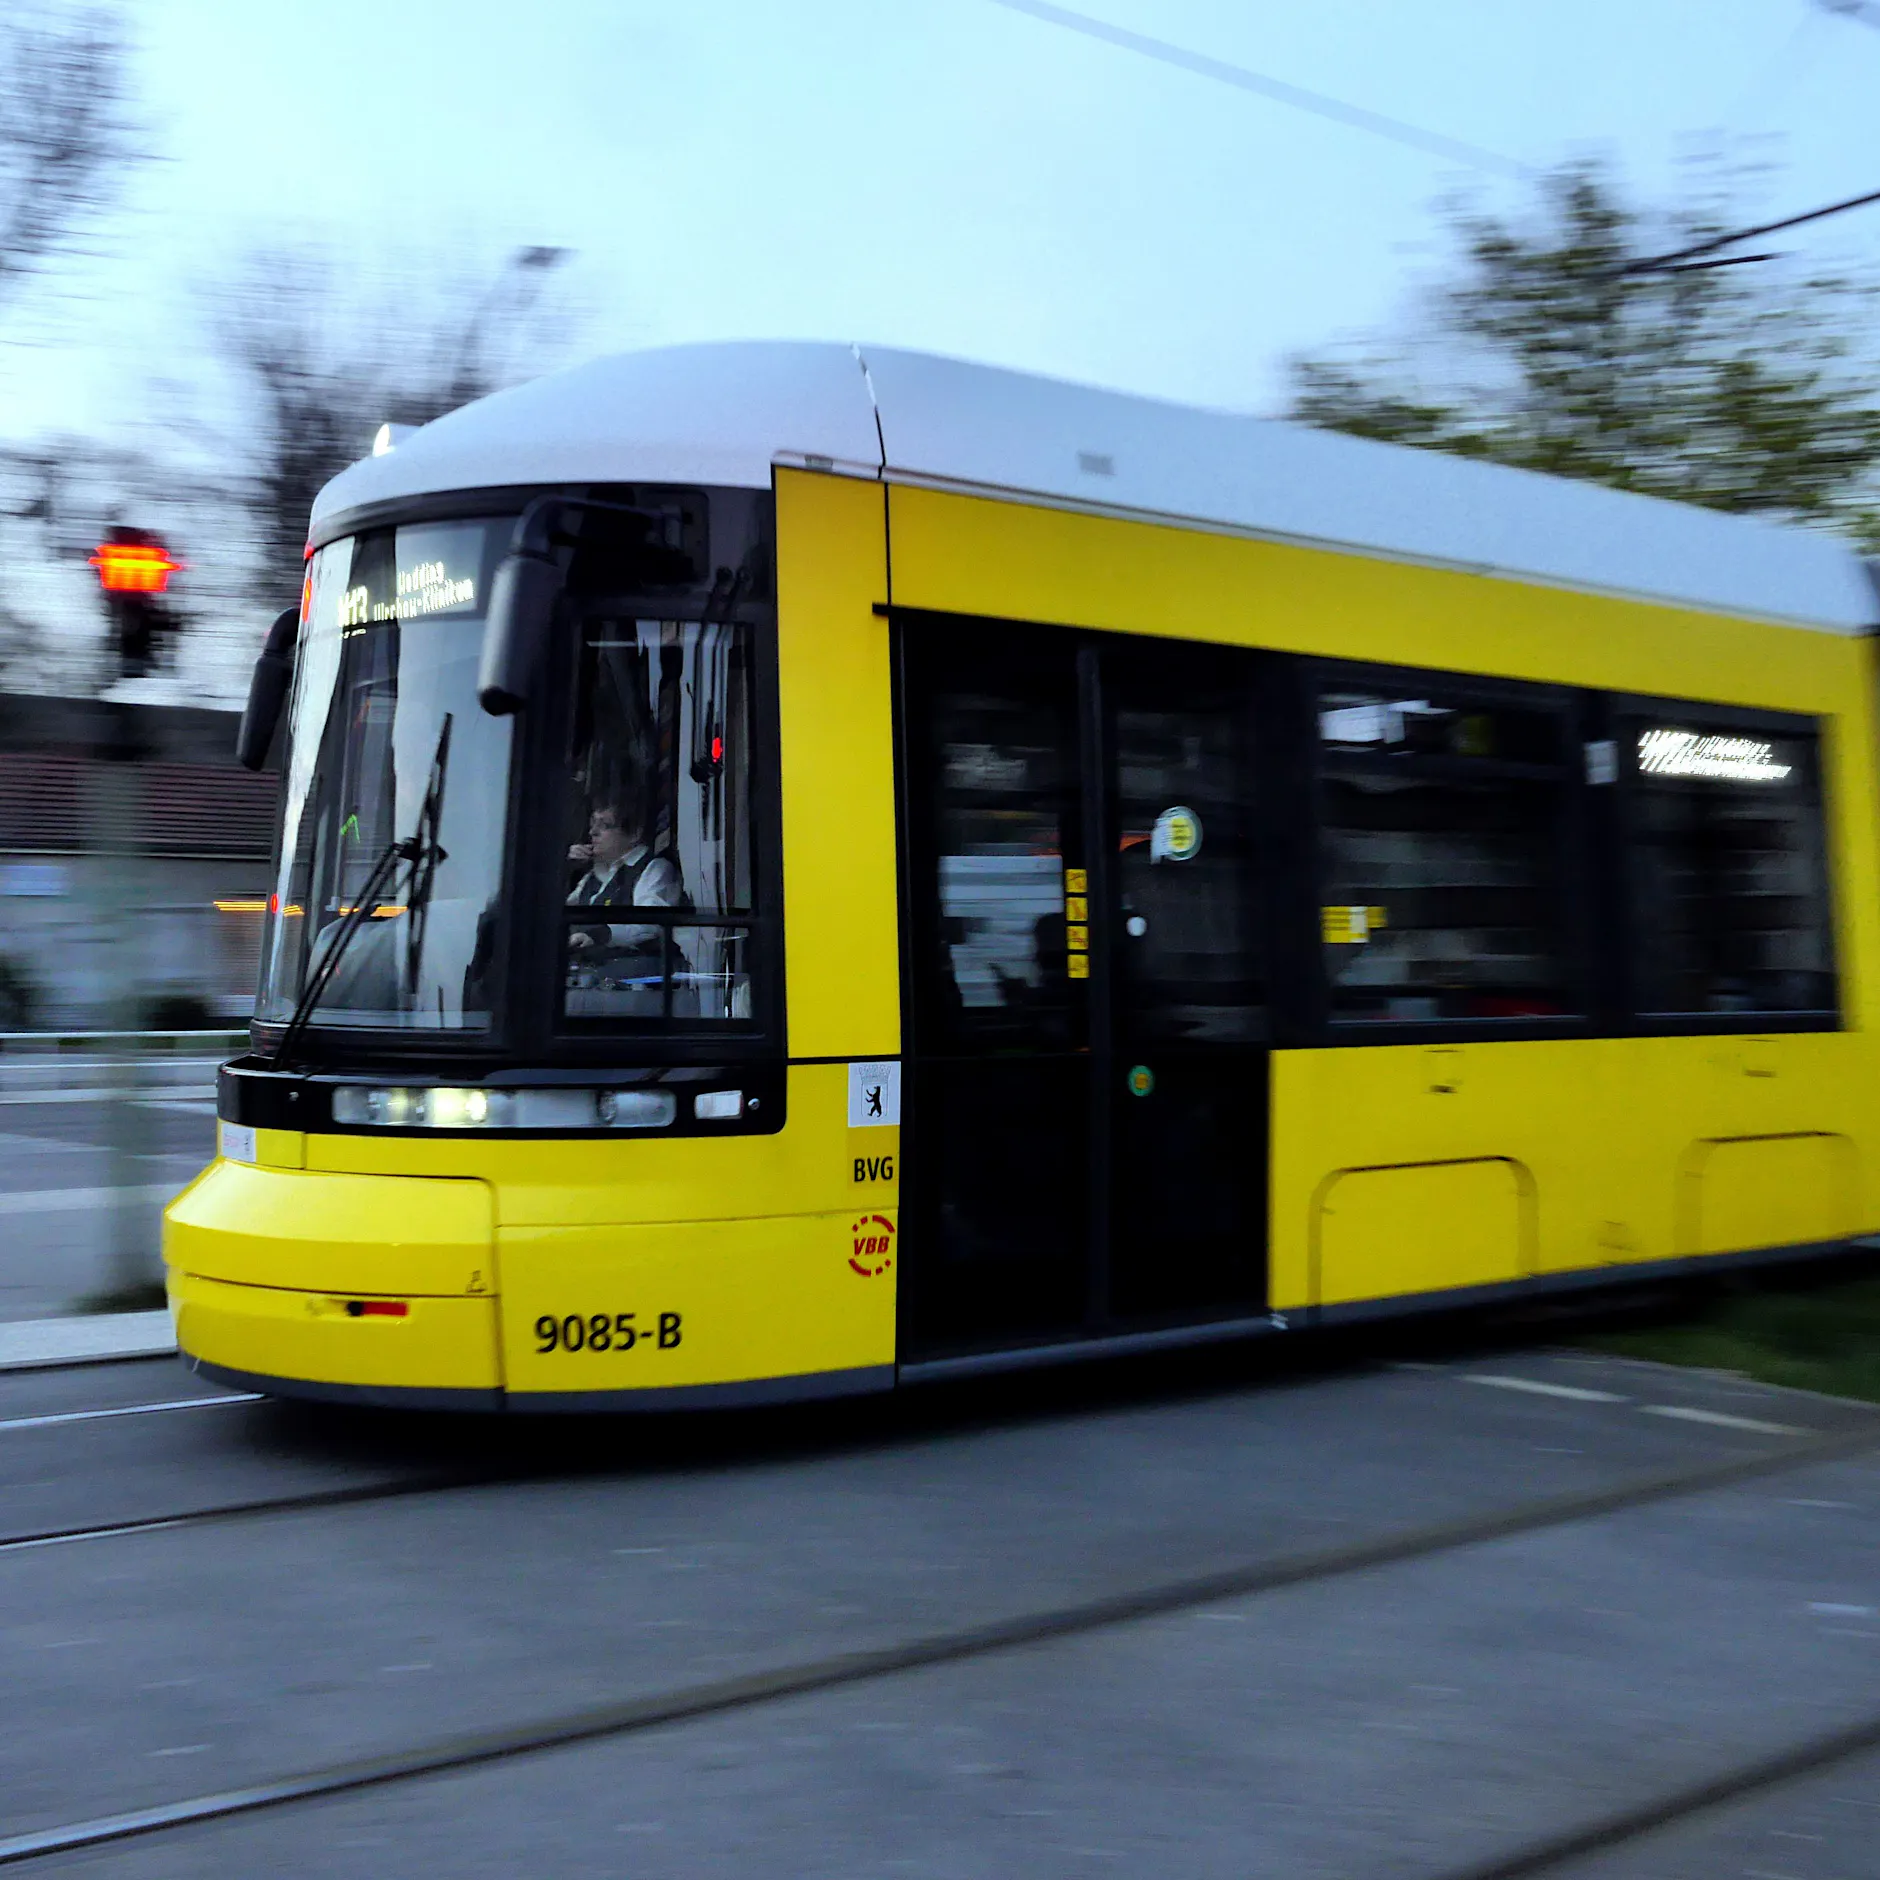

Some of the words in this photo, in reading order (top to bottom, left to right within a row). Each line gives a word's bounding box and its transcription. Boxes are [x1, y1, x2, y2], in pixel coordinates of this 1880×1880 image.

[853, 1156, 894, 1183] BVG
[853, 1235, 890, 1255] VBB
[535, 1312, 683, 1354] 9085-B
